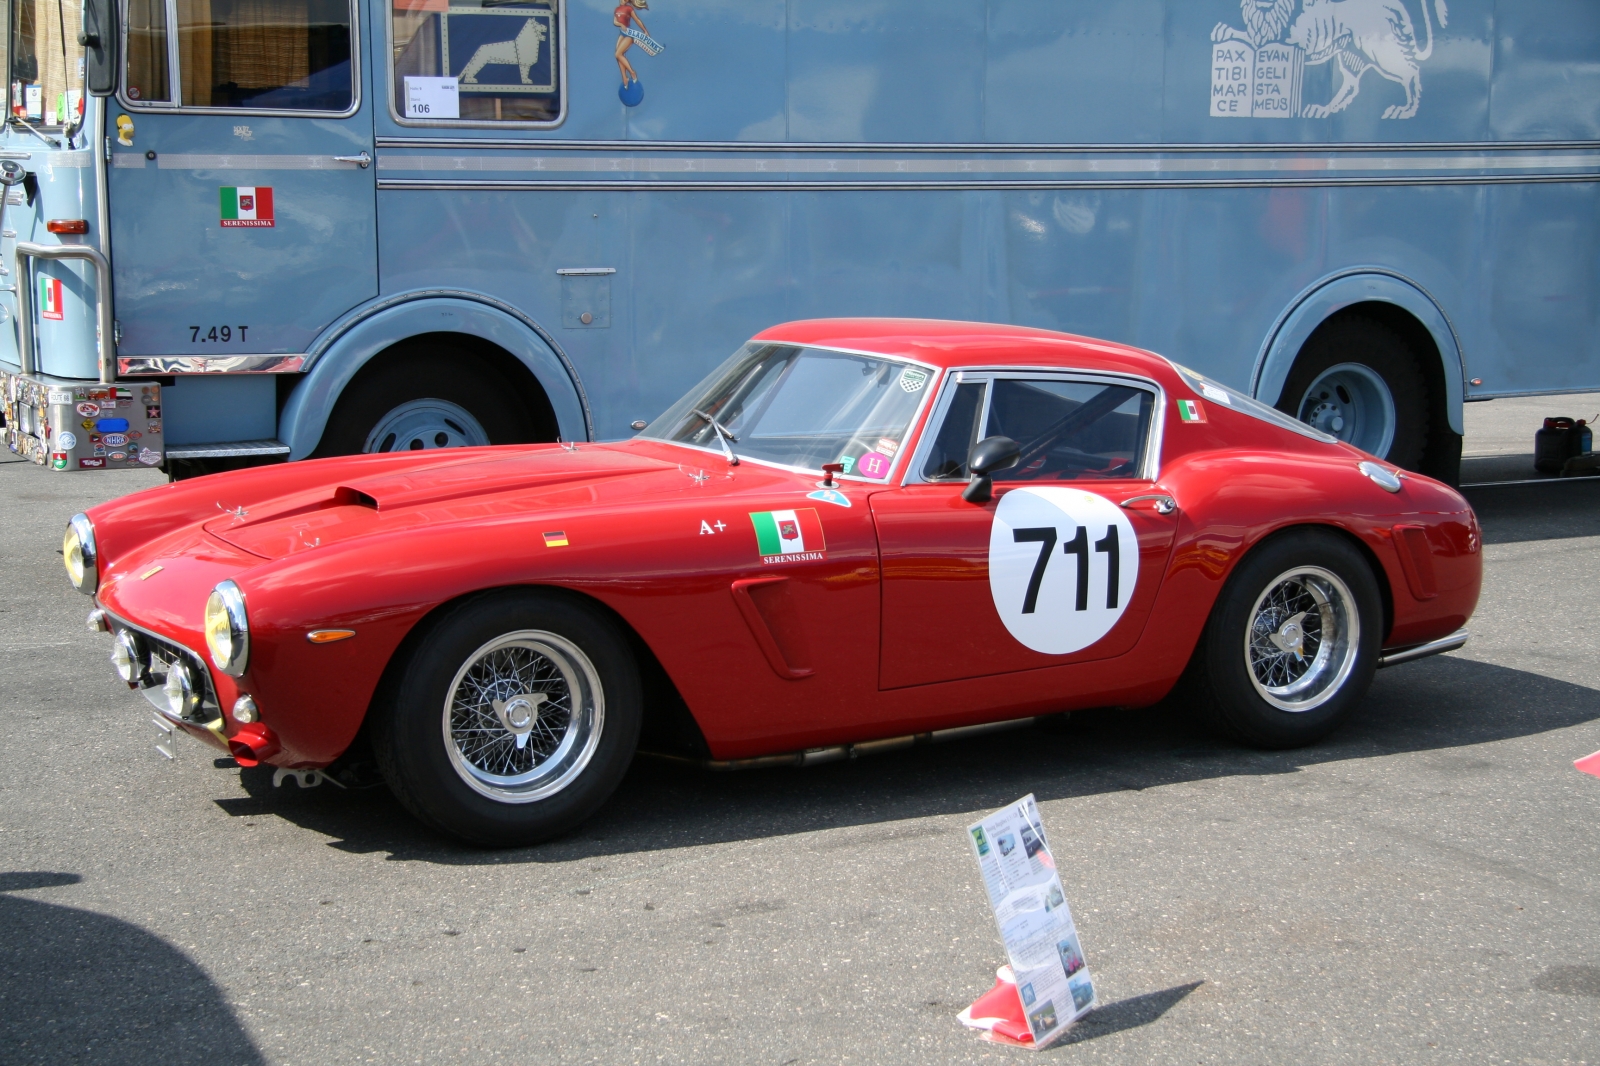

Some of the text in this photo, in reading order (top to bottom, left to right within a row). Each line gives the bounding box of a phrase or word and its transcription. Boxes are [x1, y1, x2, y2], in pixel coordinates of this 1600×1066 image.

[627, 29, 663, 53] BLAUPUNKT
[1216, 49, 1246, 63] PAX
[1258, 49, 1290, 63] EVAN
[1214, 66, 1247, 81] TIBI
[1256, 67, 1286, 80] GELI
[1213, 83, 1247, 97] MAR
[1256, 83, 1281, 96] STA
[412, 104, 430, 114] 106
[1217, 100, 1239, 112] CE
[1254, 97, 1288, 111] MEUS
[189, 325, 249, 343] 7.49 T
[106, 435, 125, 445] NHRA
[866, 457, 883, 474] H
[699, 519, 727, 535] A+
[763, 552, 824, 565] SERENISSIMA
[1012, 524, 1120, 615] 711
